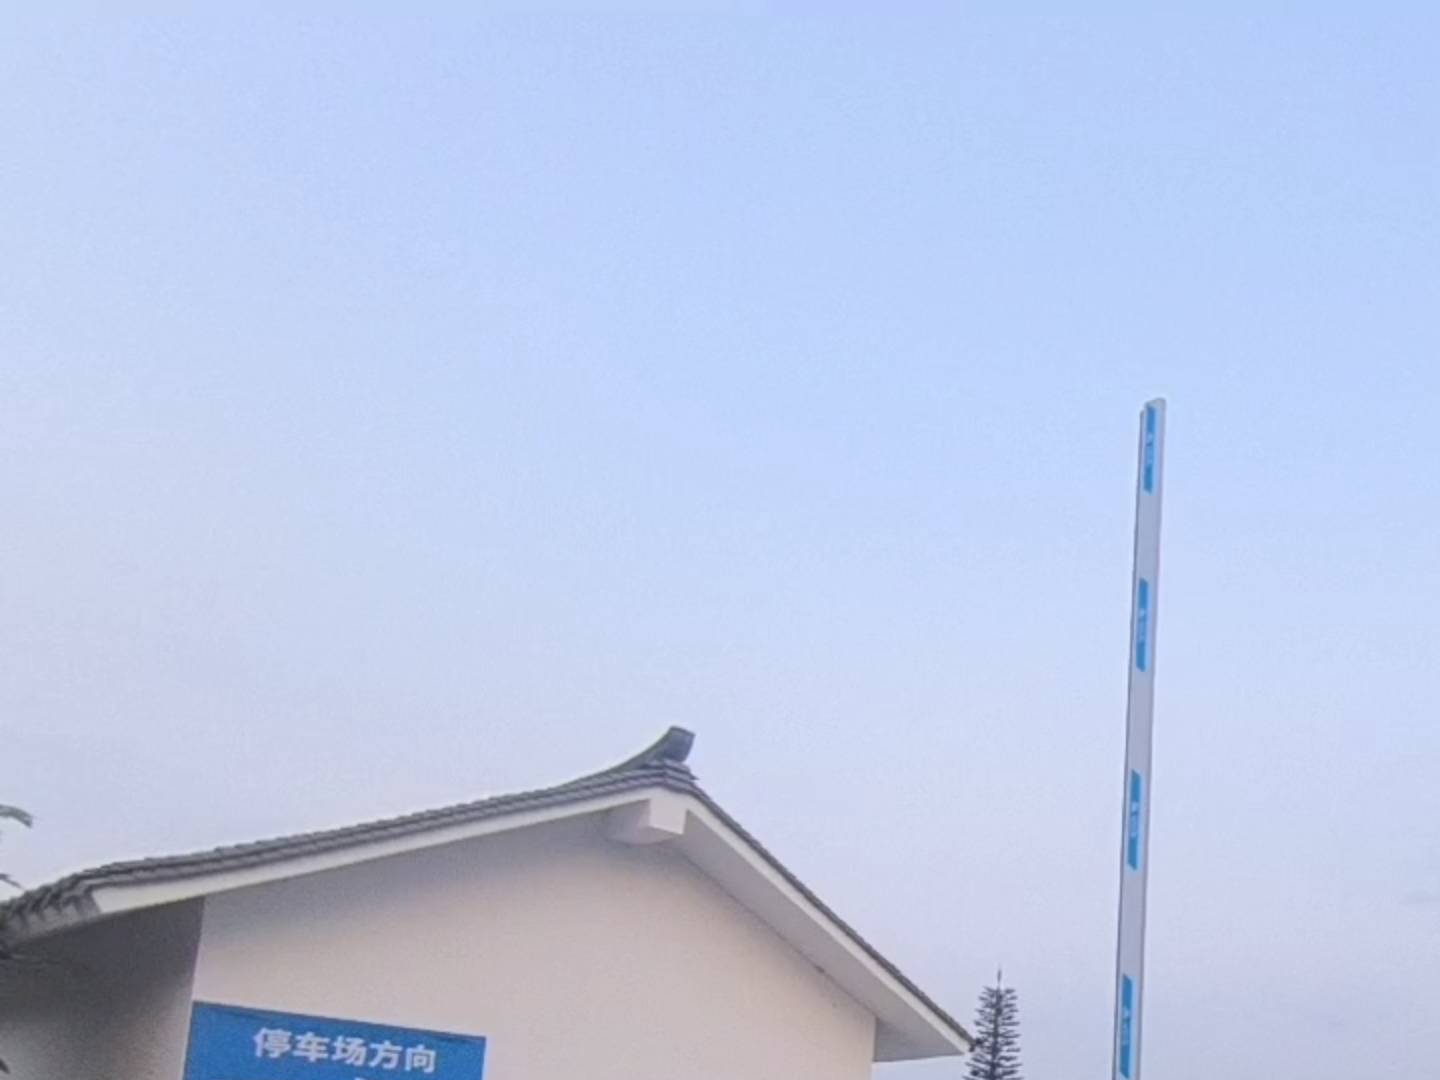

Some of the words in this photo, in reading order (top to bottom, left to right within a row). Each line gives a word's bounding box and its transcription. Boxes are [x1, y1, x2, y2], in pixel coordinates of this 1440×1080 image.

[254, 1027, 437, 1073] 停车场方向
